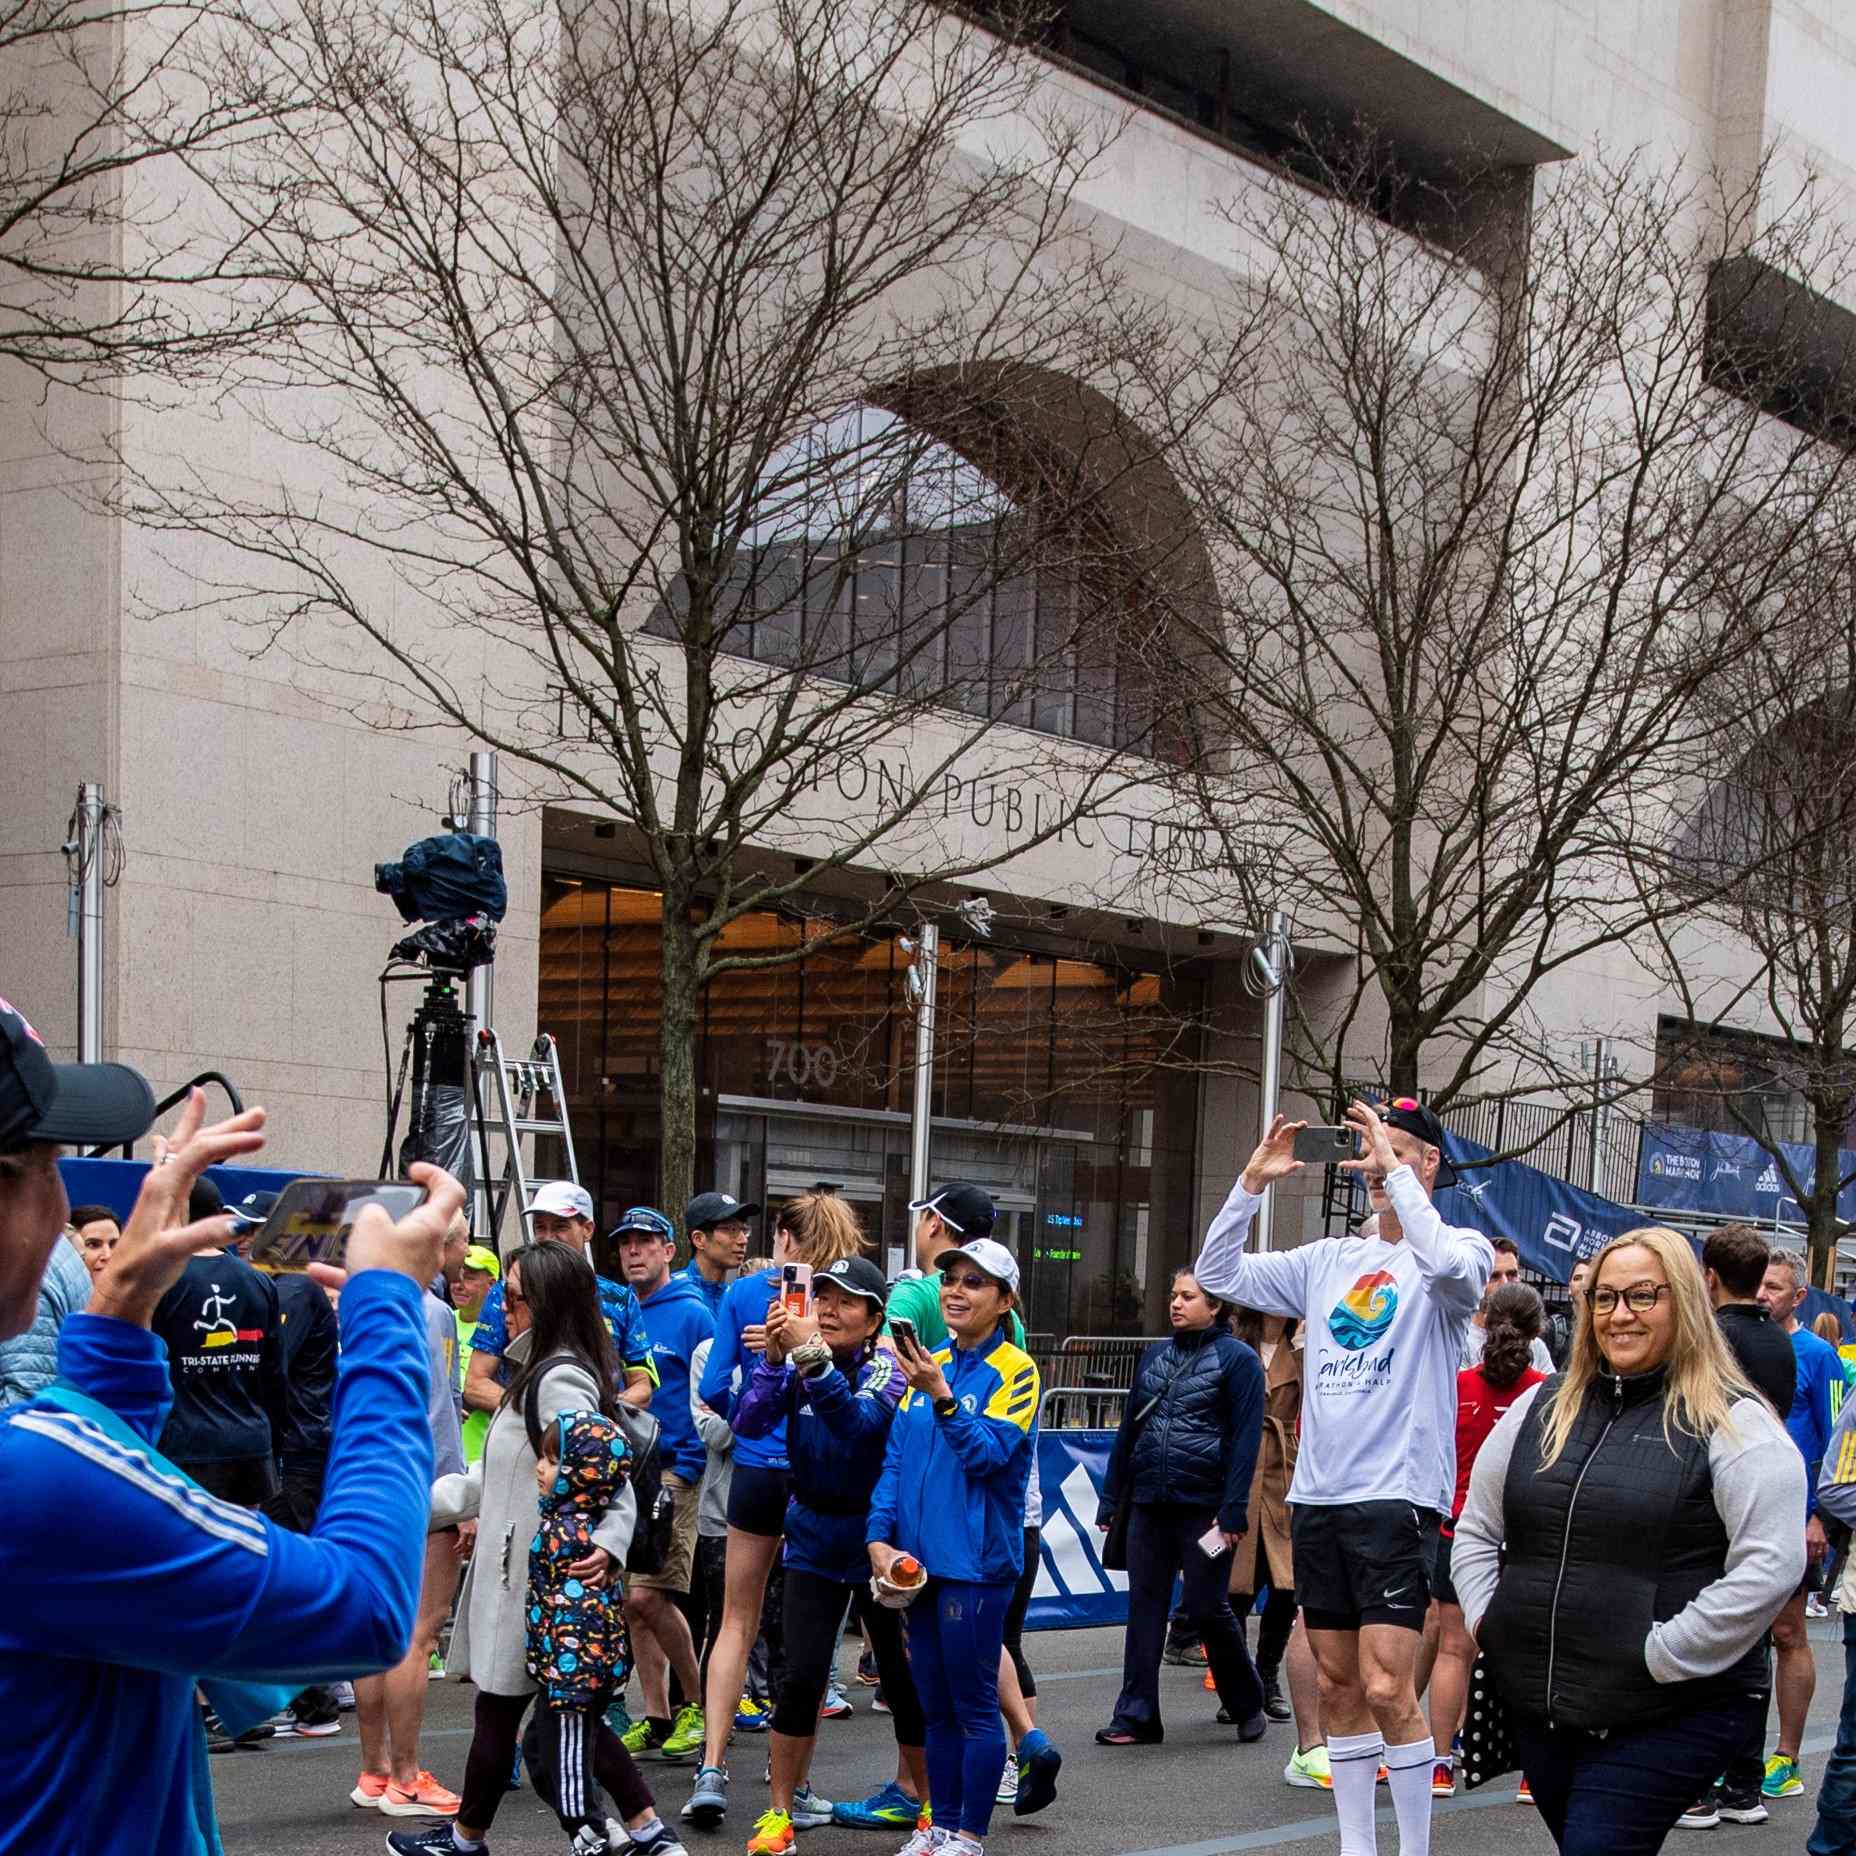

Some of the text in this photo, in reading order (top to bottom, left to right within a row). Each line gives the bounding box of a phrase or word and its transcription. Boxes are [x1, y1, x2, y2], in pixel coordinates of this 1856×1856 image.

[943, 772, 1095, 849] PUBLIC
[765, 1039, 837, 1087] 700
[181, 1355, 230, 1367] TRI-STATE
